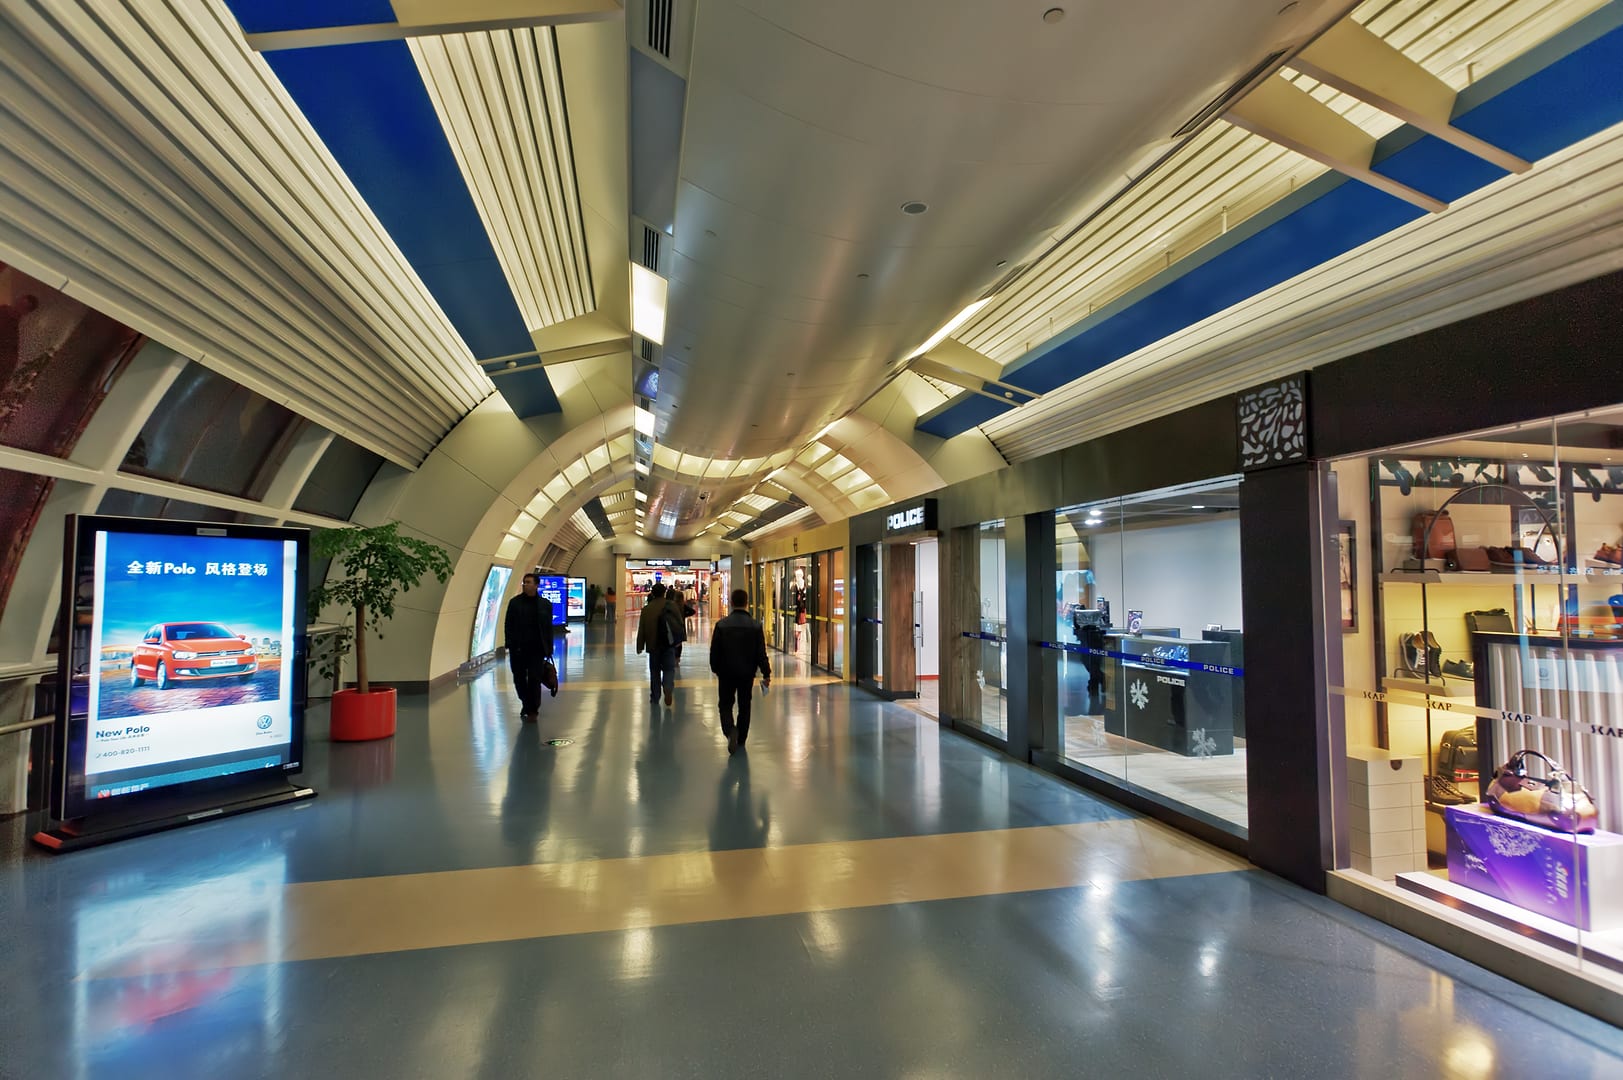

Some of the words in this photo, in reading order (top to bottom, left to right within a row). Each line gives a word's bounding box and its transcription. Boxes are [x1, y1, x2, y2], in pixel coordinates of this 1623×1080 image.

[887, 506, 925, 530] POLICE
[127, 560, 196, 575] 全新Polo
[205, 562, 268, 576] 风格登场
[1088, 648, 1108, 657] POLICE
[1140, 656, 1165, 664] POLICE
[1203, 664, 1234, 675] POLICE
[1156, 676, 1186, 687] POLICE
[96, 730, 123, 739] New
[126, 725, 150, 735] Polo
